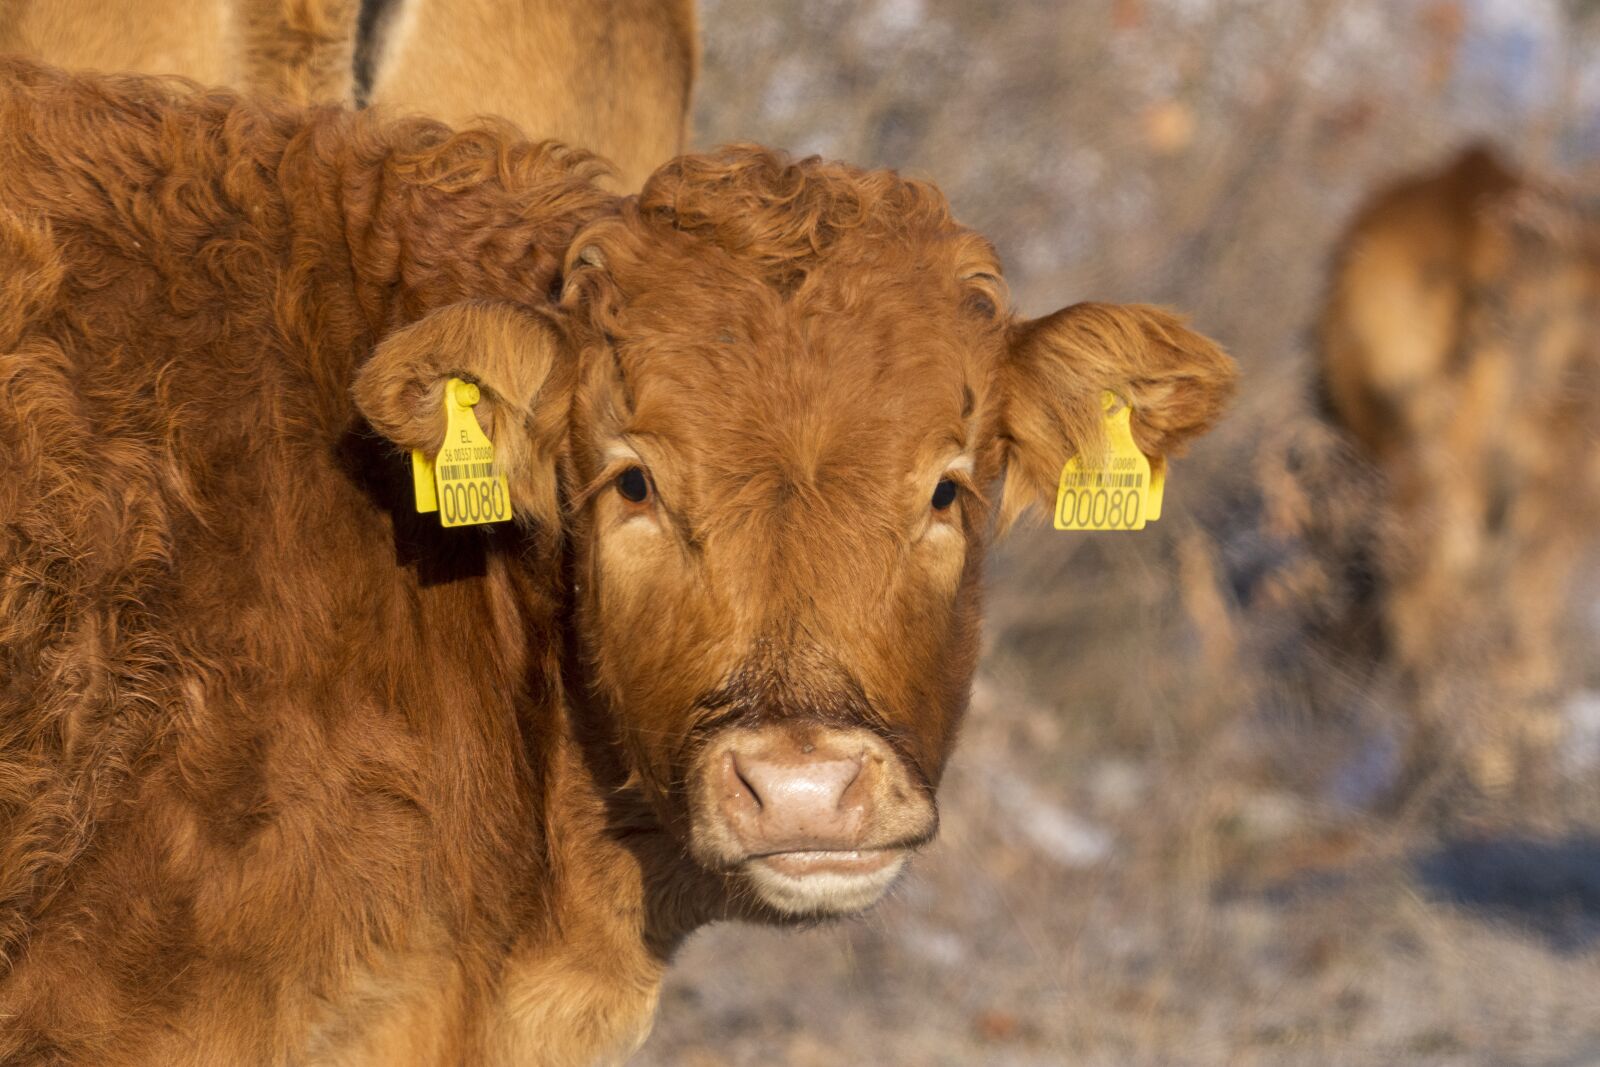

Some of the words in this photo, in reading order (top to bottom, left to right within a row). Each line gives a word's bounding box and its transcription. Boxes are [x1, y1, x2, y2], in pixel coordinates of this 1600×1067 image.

[460, 430, 472, 443] EL
[444, 480, 504, 523] 00080
[1061, 488, 1139, 528] 00080
